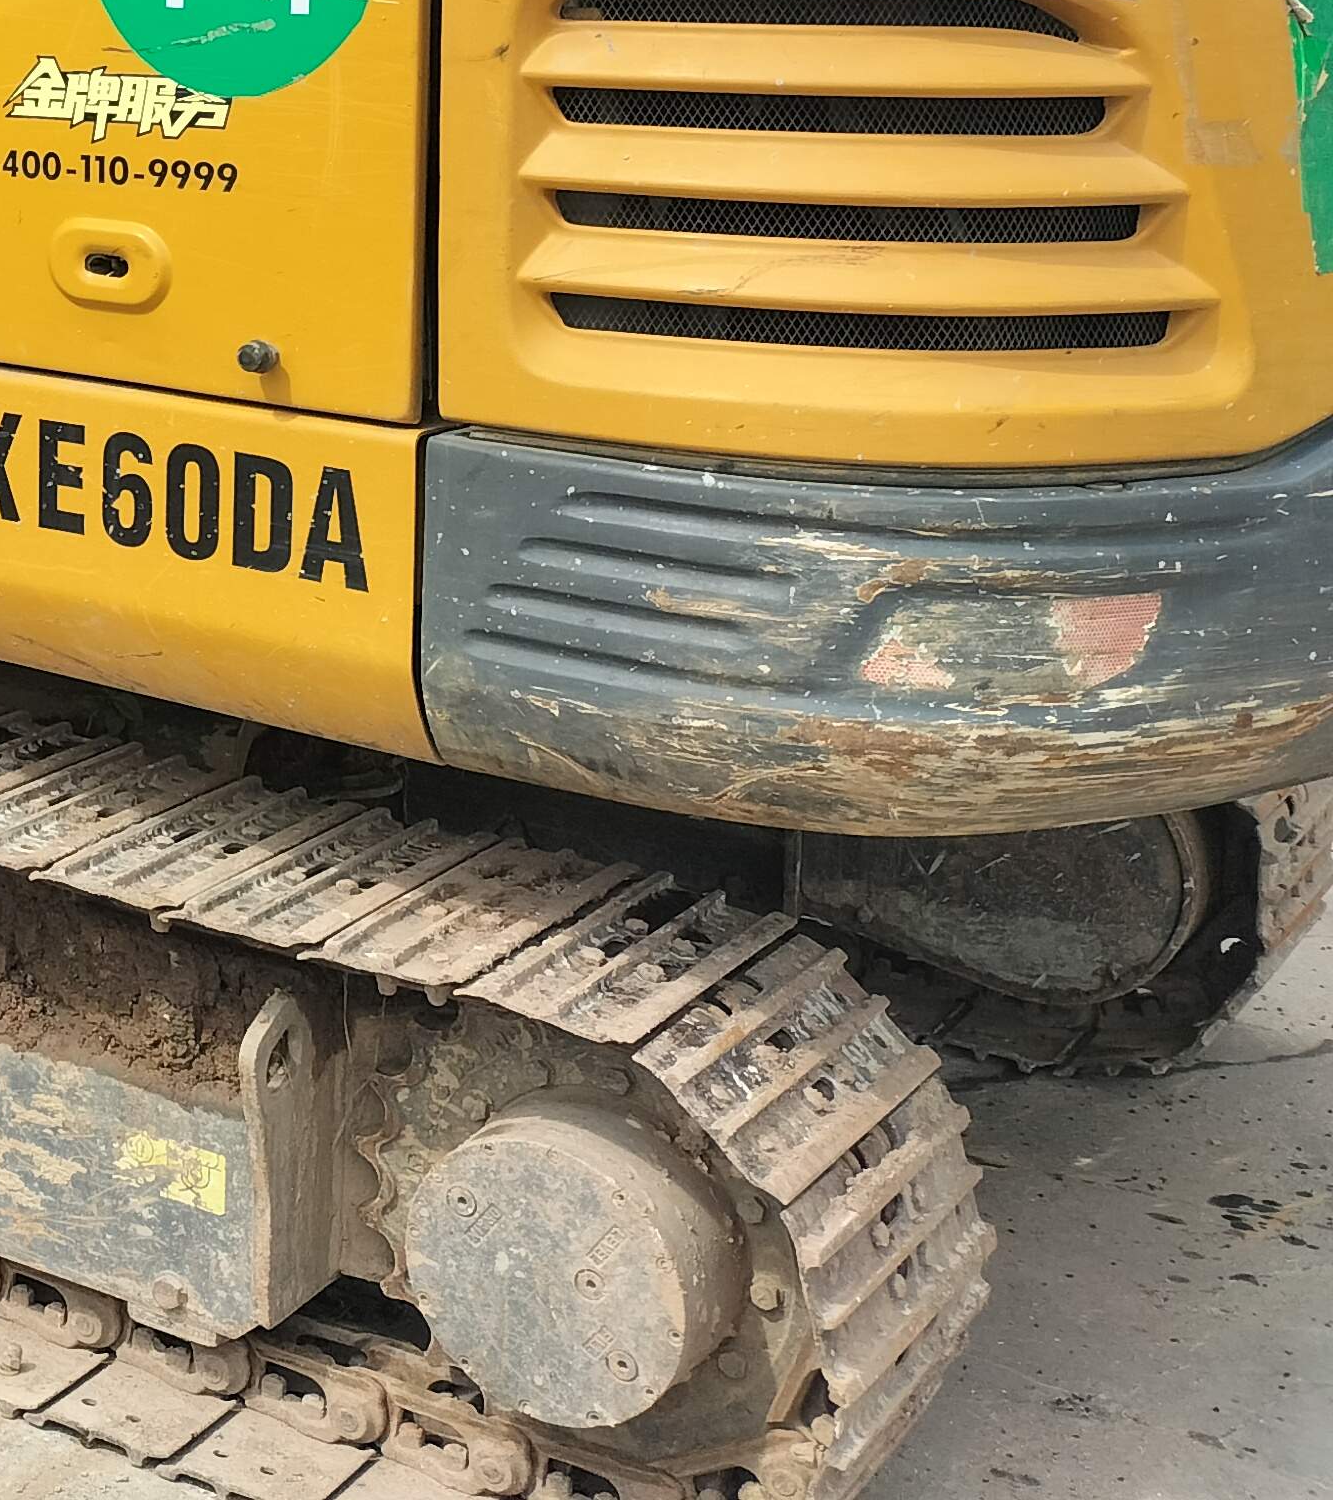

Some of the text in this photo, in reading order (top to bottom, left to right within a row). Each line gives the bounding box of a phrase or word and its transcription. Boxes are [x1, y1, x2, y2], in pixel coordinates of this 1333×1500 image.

[4, 56, 232, 142] 金牌服务
[2, 150, 238, 193] 400-110-9999
